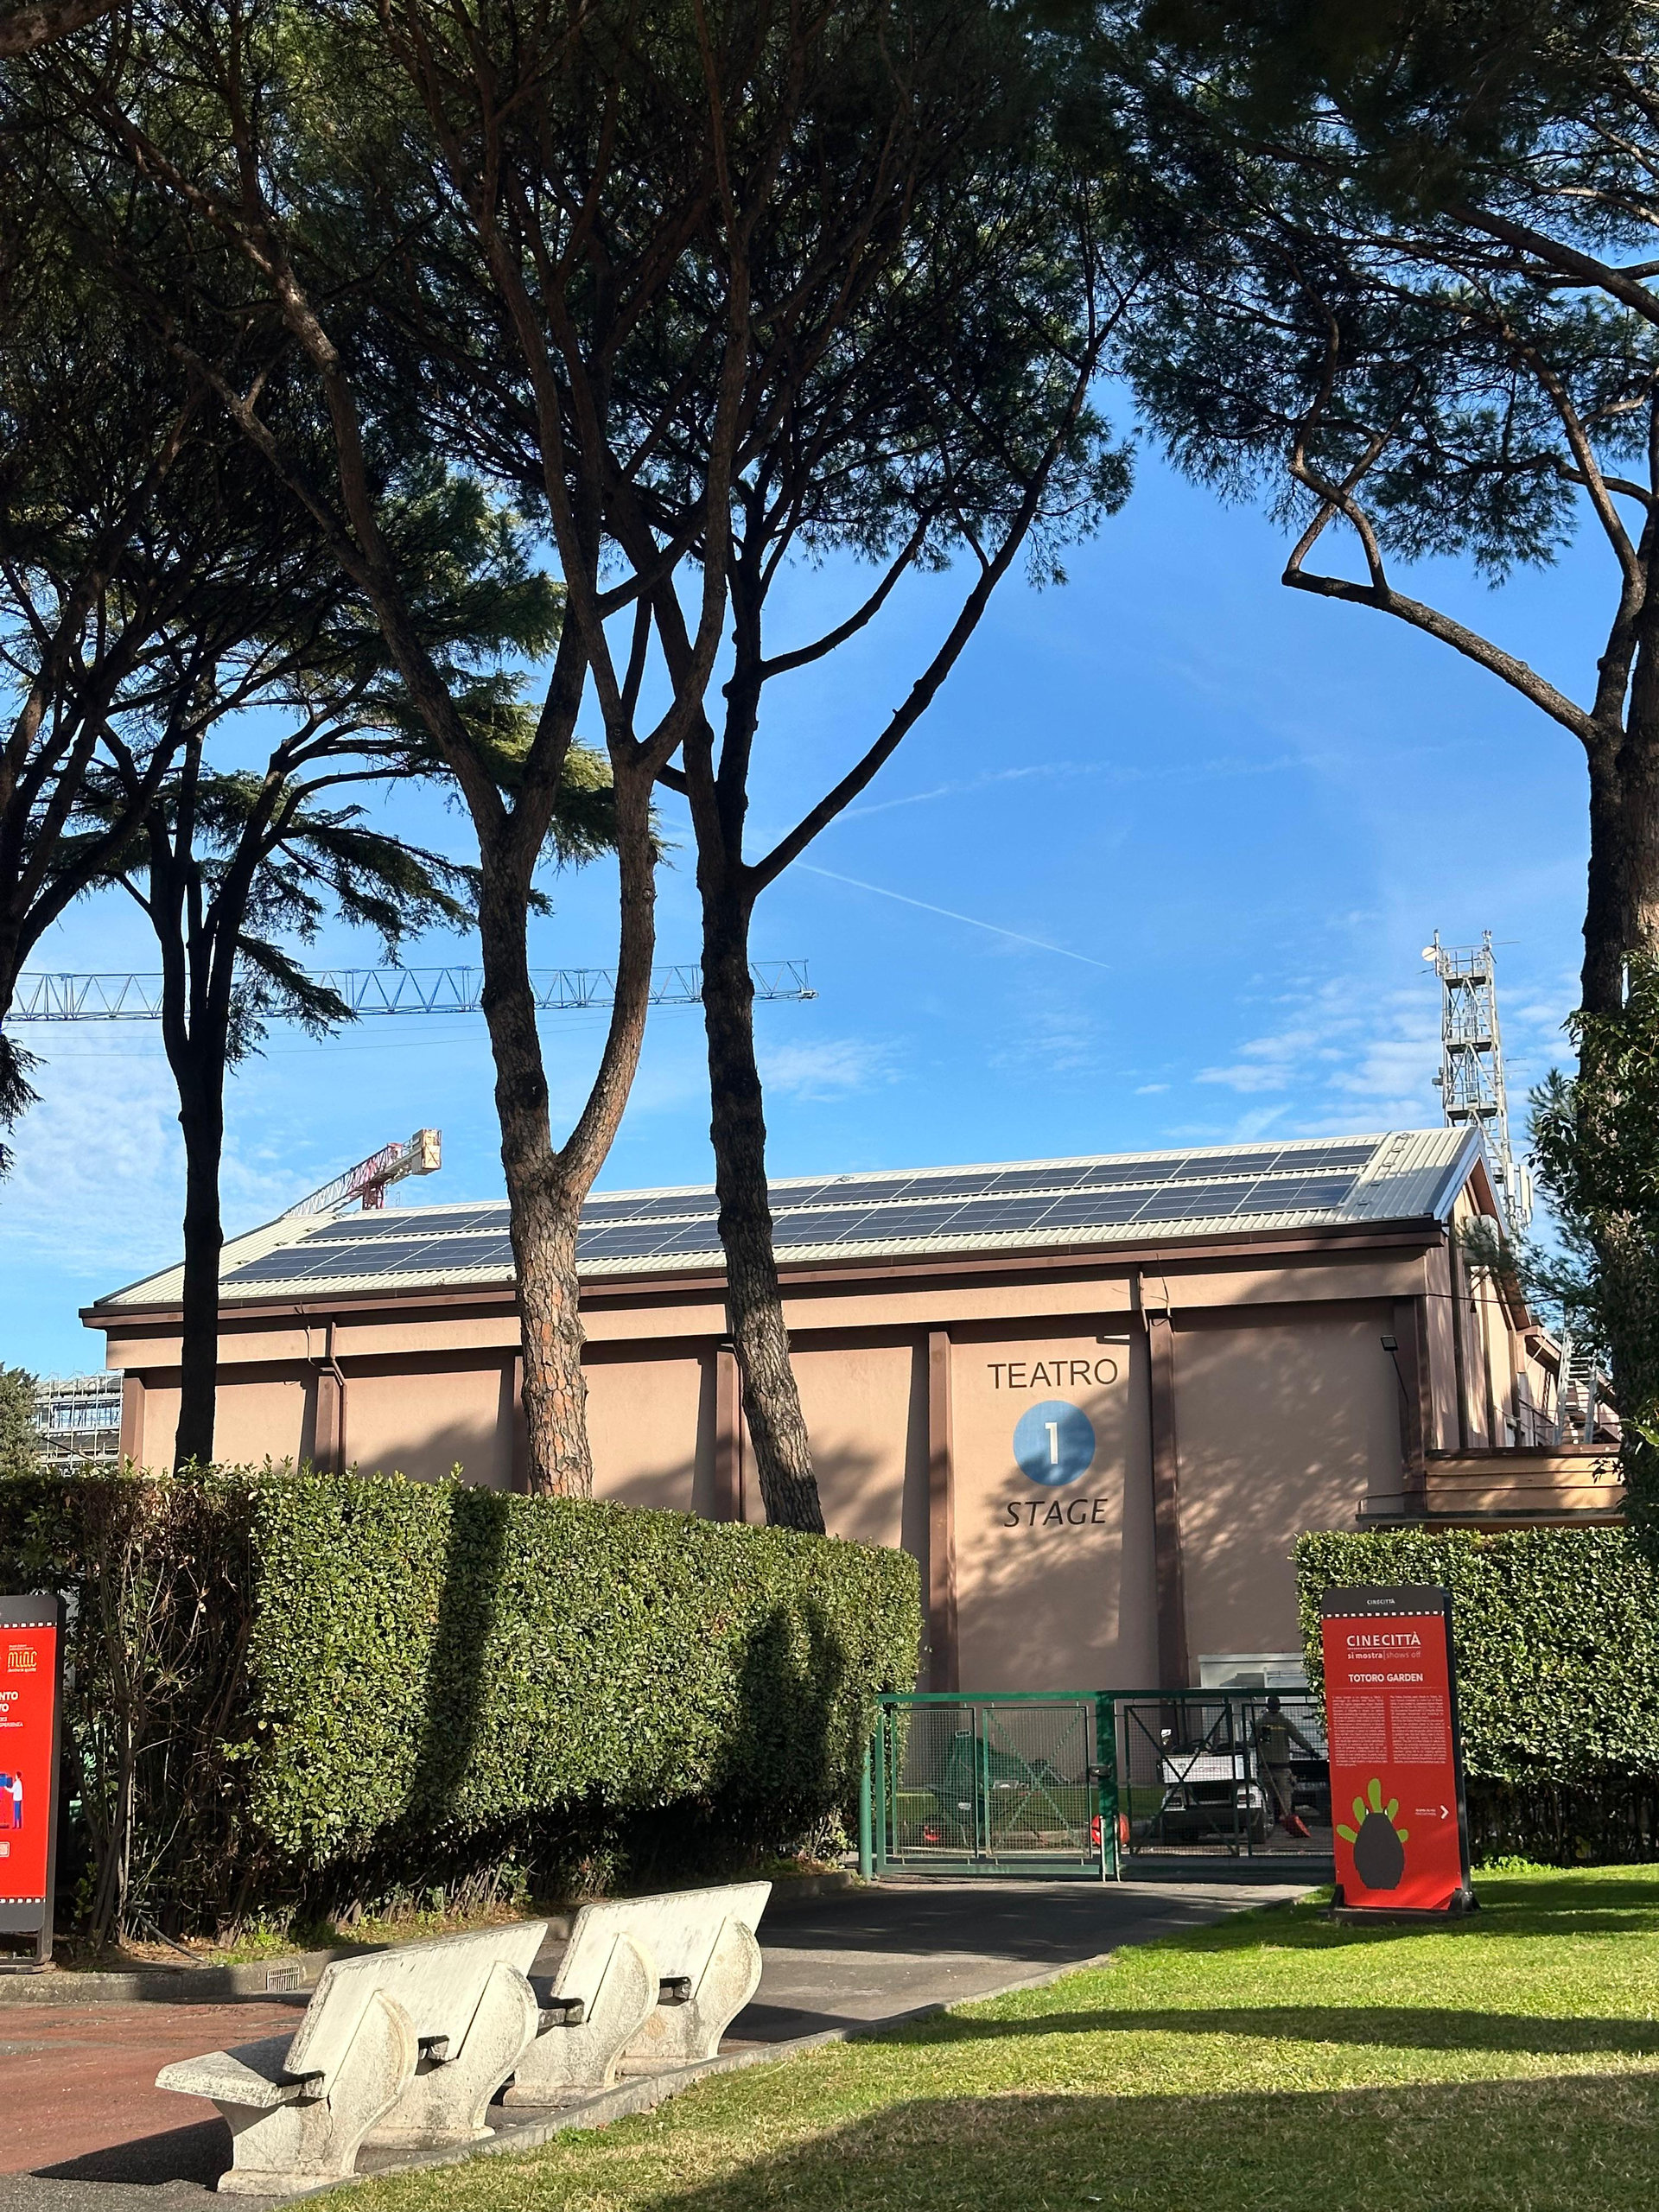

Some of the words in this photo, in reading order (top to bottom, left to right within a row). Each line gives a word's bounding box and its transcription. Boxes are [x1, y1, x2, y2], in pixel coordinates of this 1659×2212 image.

[987, 1358, 1118, 1389] TEATRO
[1044, 1421, 1059, 1465] 1
[1003, 1498, 1109, 1528] STAGE
[1346, 1630, 1421, 1646] CINECITTÀ
[1348, 1673, 1384, 1682] TOTORO
[1386, 1673, 1423, 1682] GARDEN
